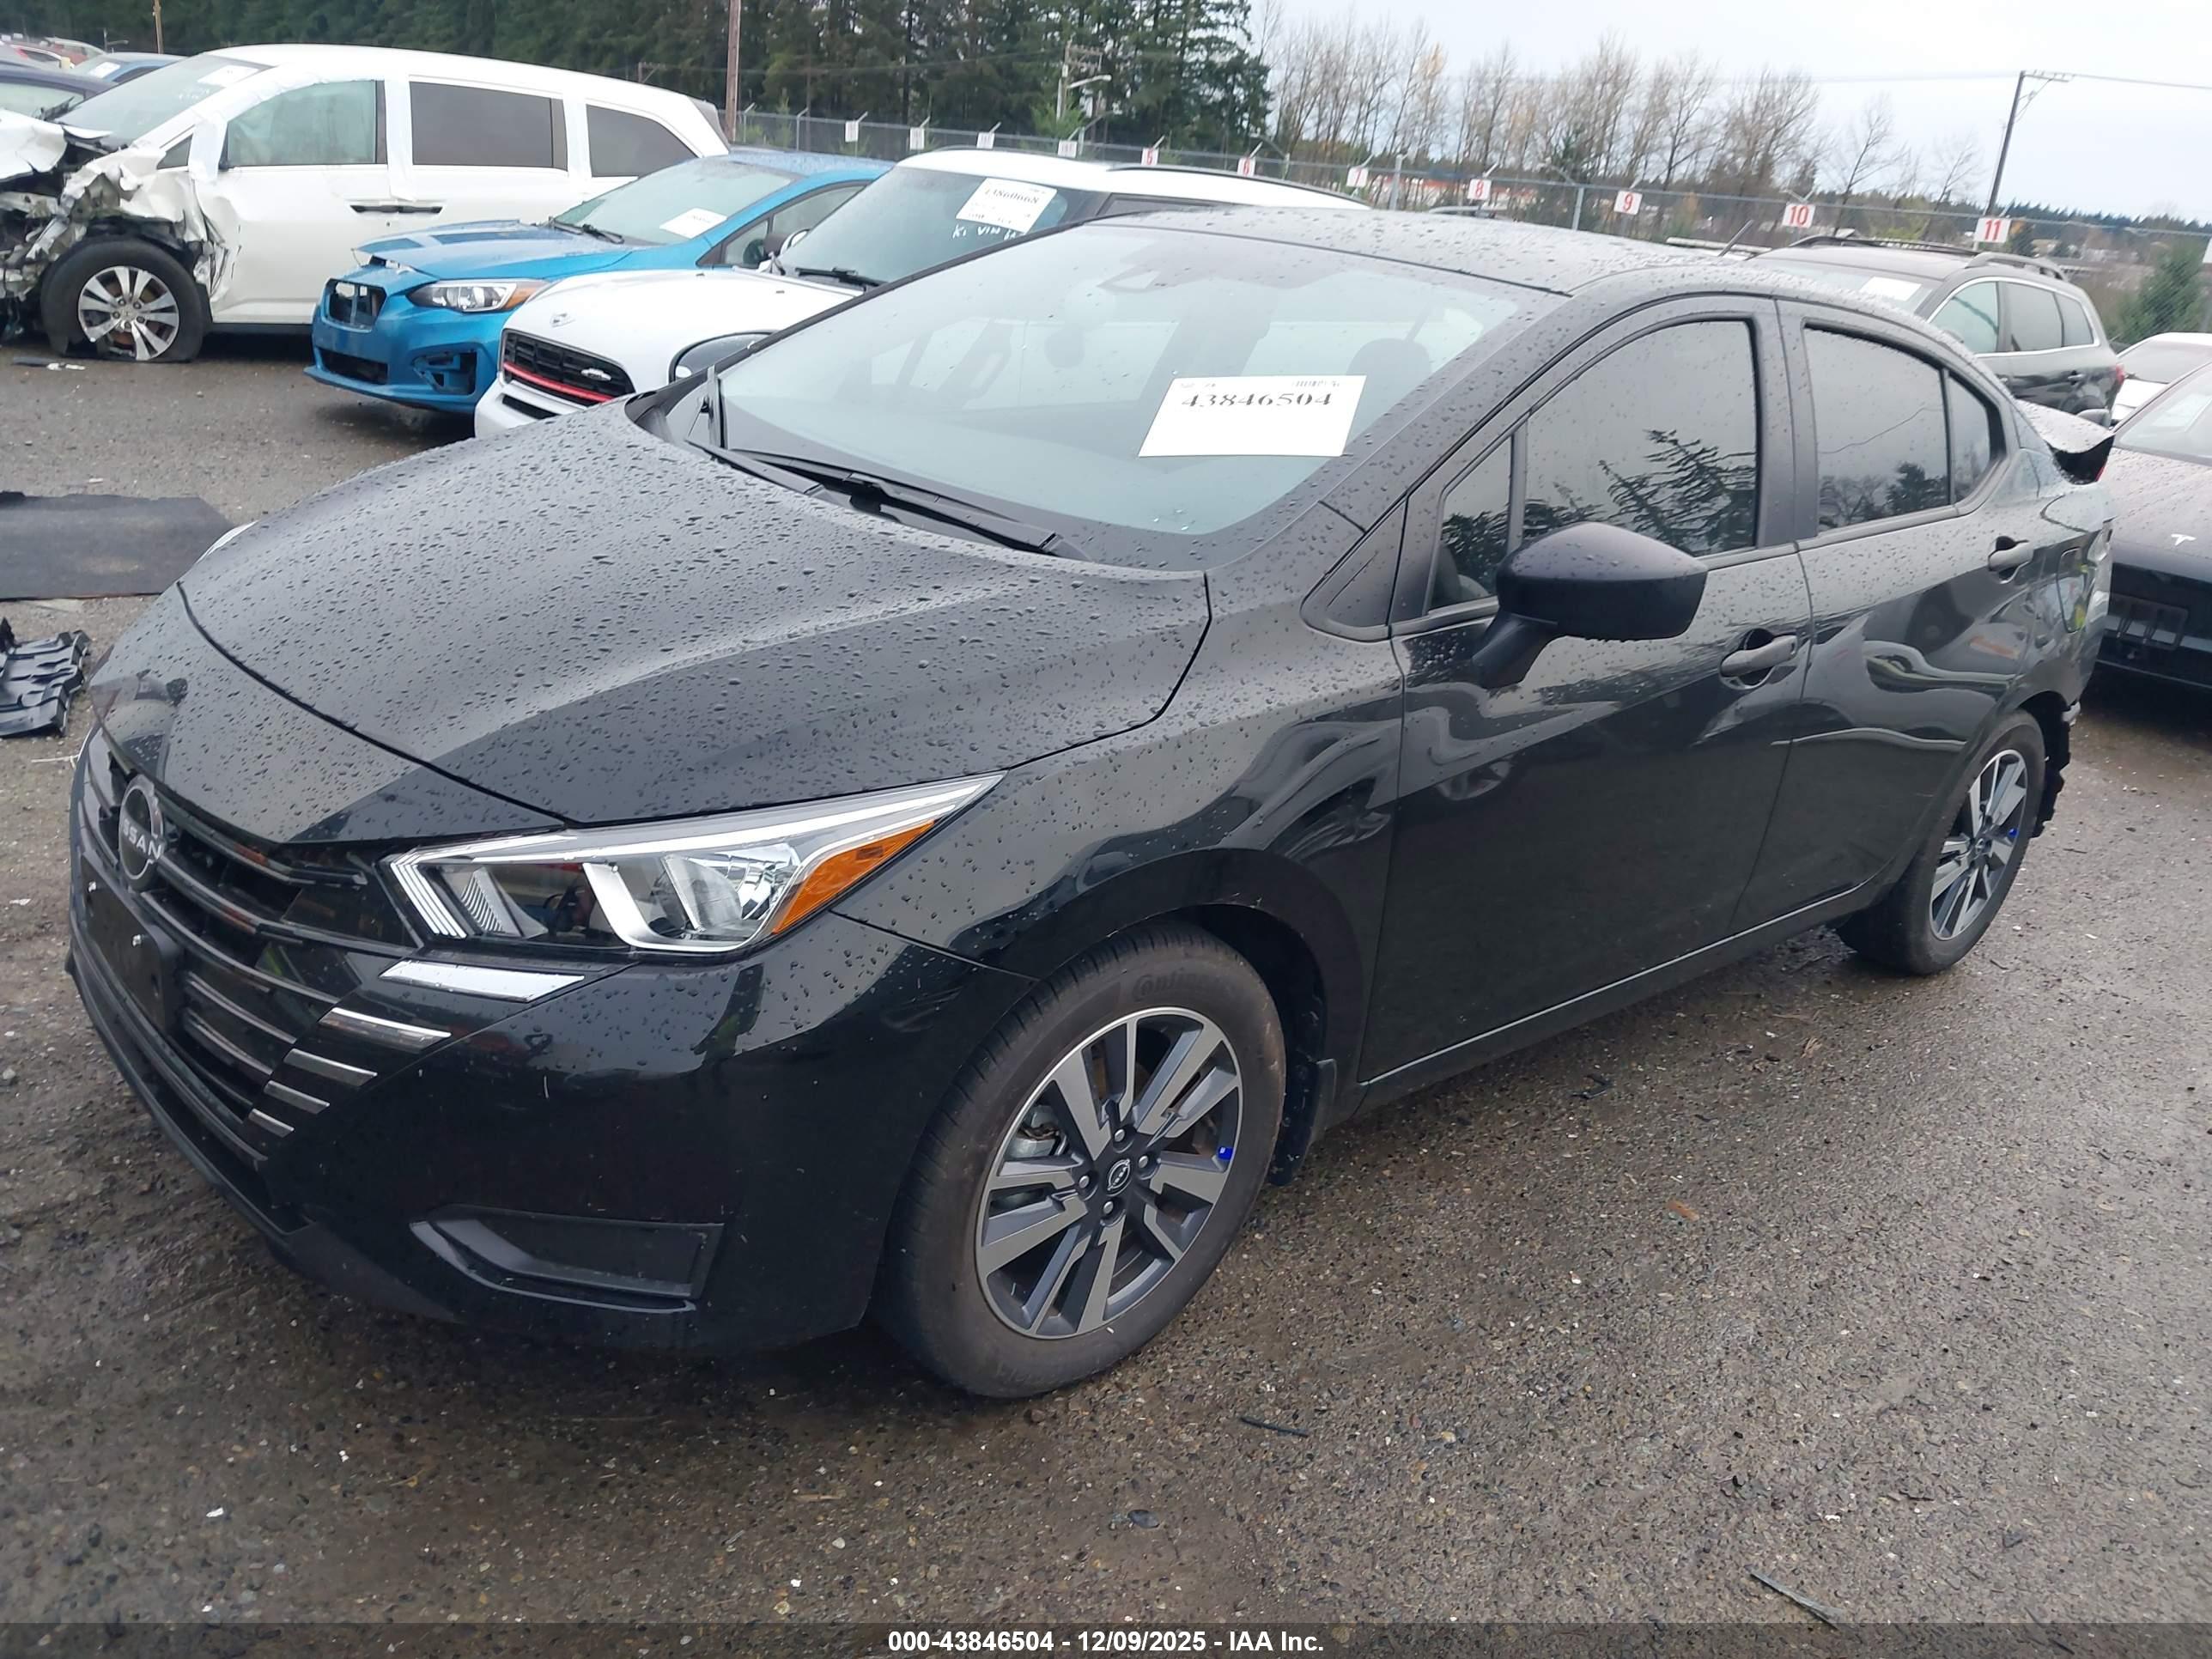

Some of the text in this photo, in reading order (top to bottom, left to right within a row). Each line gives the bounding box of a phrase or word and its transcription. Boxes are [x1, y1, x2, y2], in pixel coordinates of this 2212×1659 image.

[1474, 179, 1485, 198] 8
[1623, 193, 1633, 211] 9
[1790, 205, 1808, 225] 10
[977, 226, 1001, 236] VIN
[1984, 220, 2001, 240] 11
[1181, 392, 1333, 408] 43846504
[122, 817, 161, 860] SSAN
